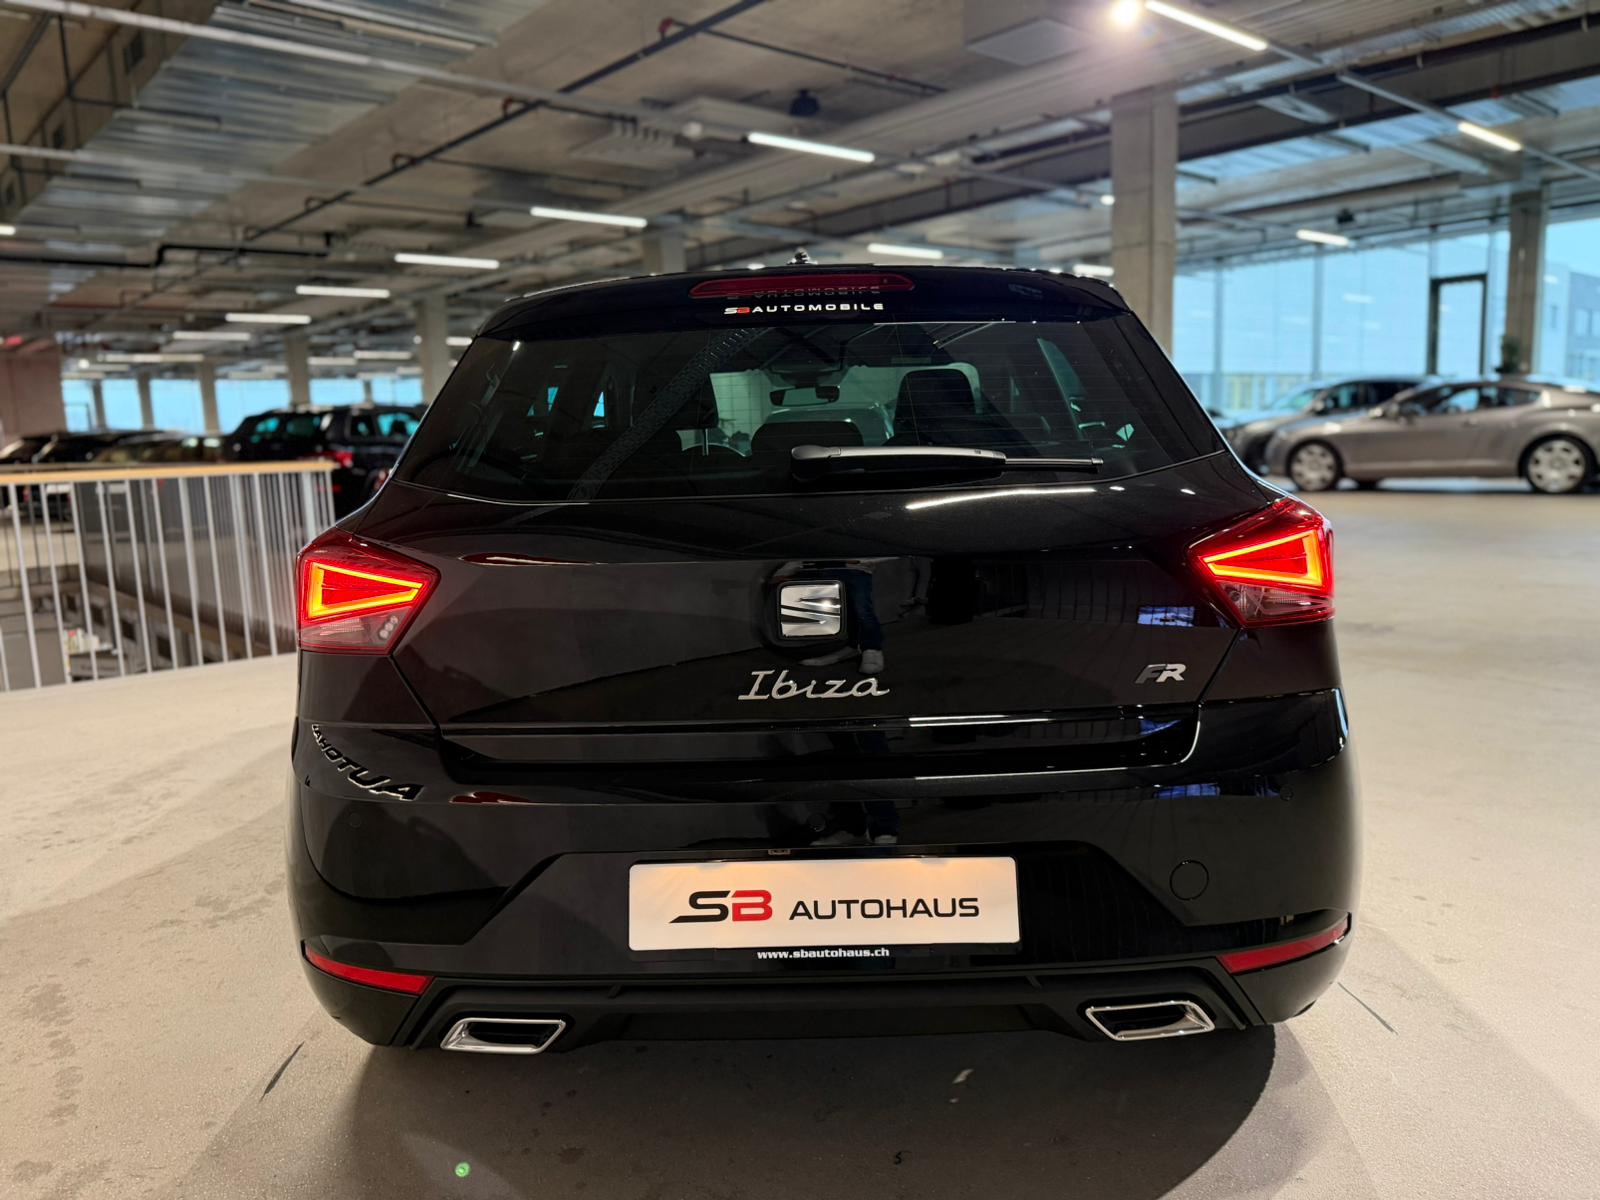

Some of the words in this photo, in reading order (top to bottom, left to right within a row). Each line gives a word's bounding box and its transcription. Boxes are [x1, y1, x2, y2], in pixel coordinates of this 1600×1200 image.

[738, 670, 890, 700] Ibiza
[1134, 663, 1187, 684] FR
[669, 889, 773, 923] SB
[789, 897, 980, 921] AUTOHAUS
[757, 947, 890, 959] www.sbautohaus.ch
